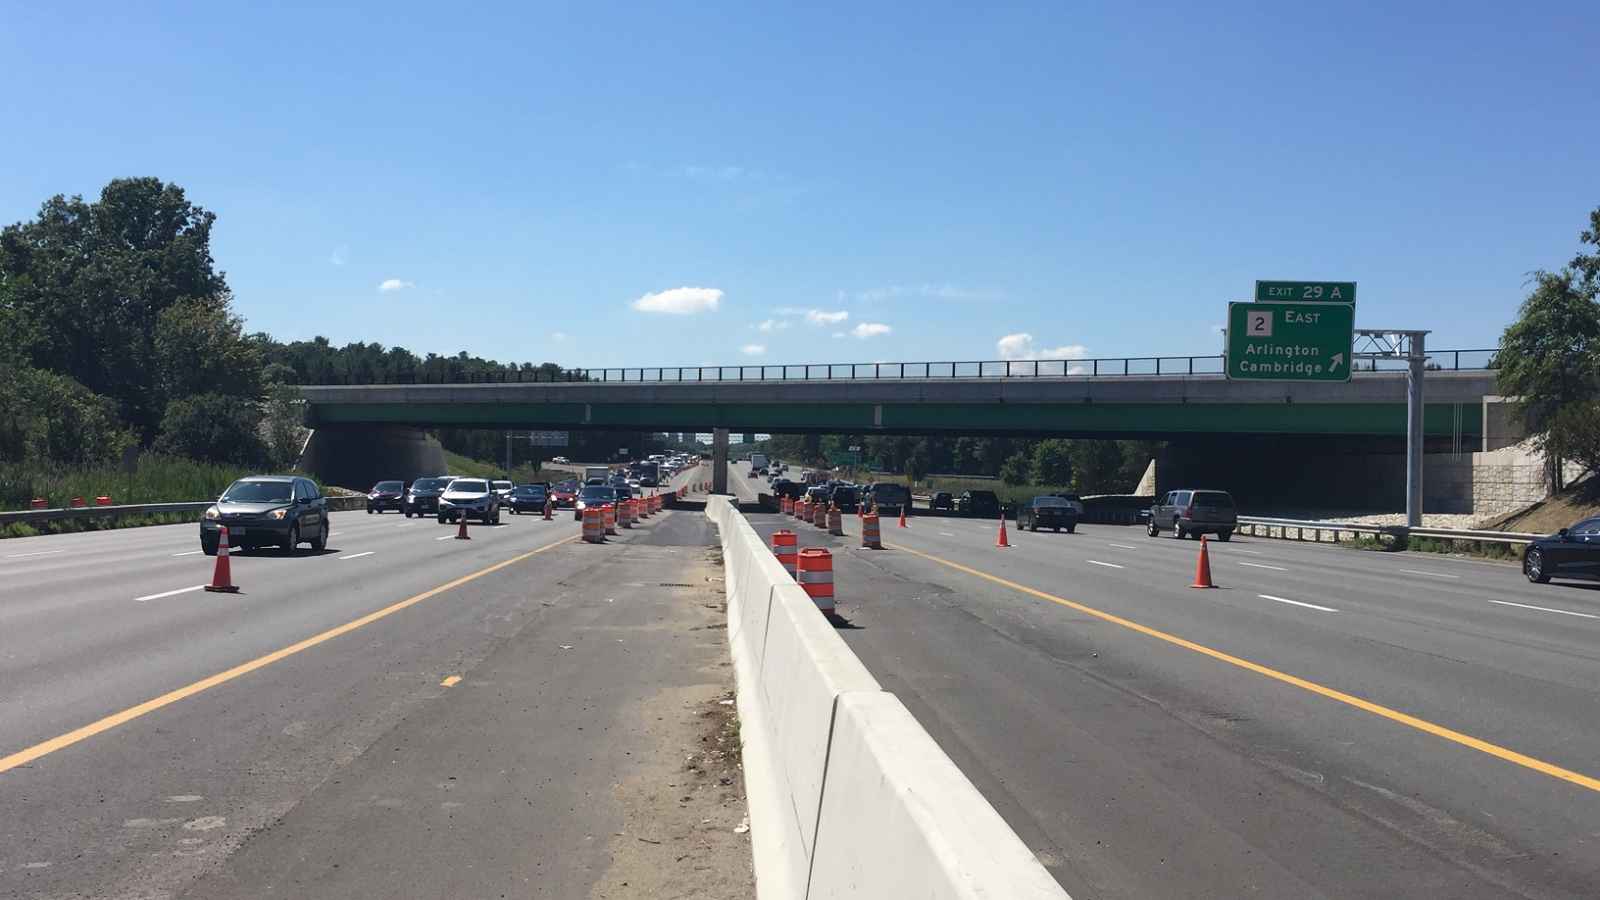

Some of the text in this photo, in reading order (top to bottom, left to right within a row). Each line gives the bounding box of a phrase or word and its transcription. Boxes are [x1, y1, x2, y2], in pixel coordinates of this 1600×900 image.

[1269, 286, 1342, 299] EXIT 29 A
[1254, 311, 1320, 331] 2 EAST
[1246, 344, 1319, 358] Arlington
[1240, 360, 1322, 375] Cambridge
